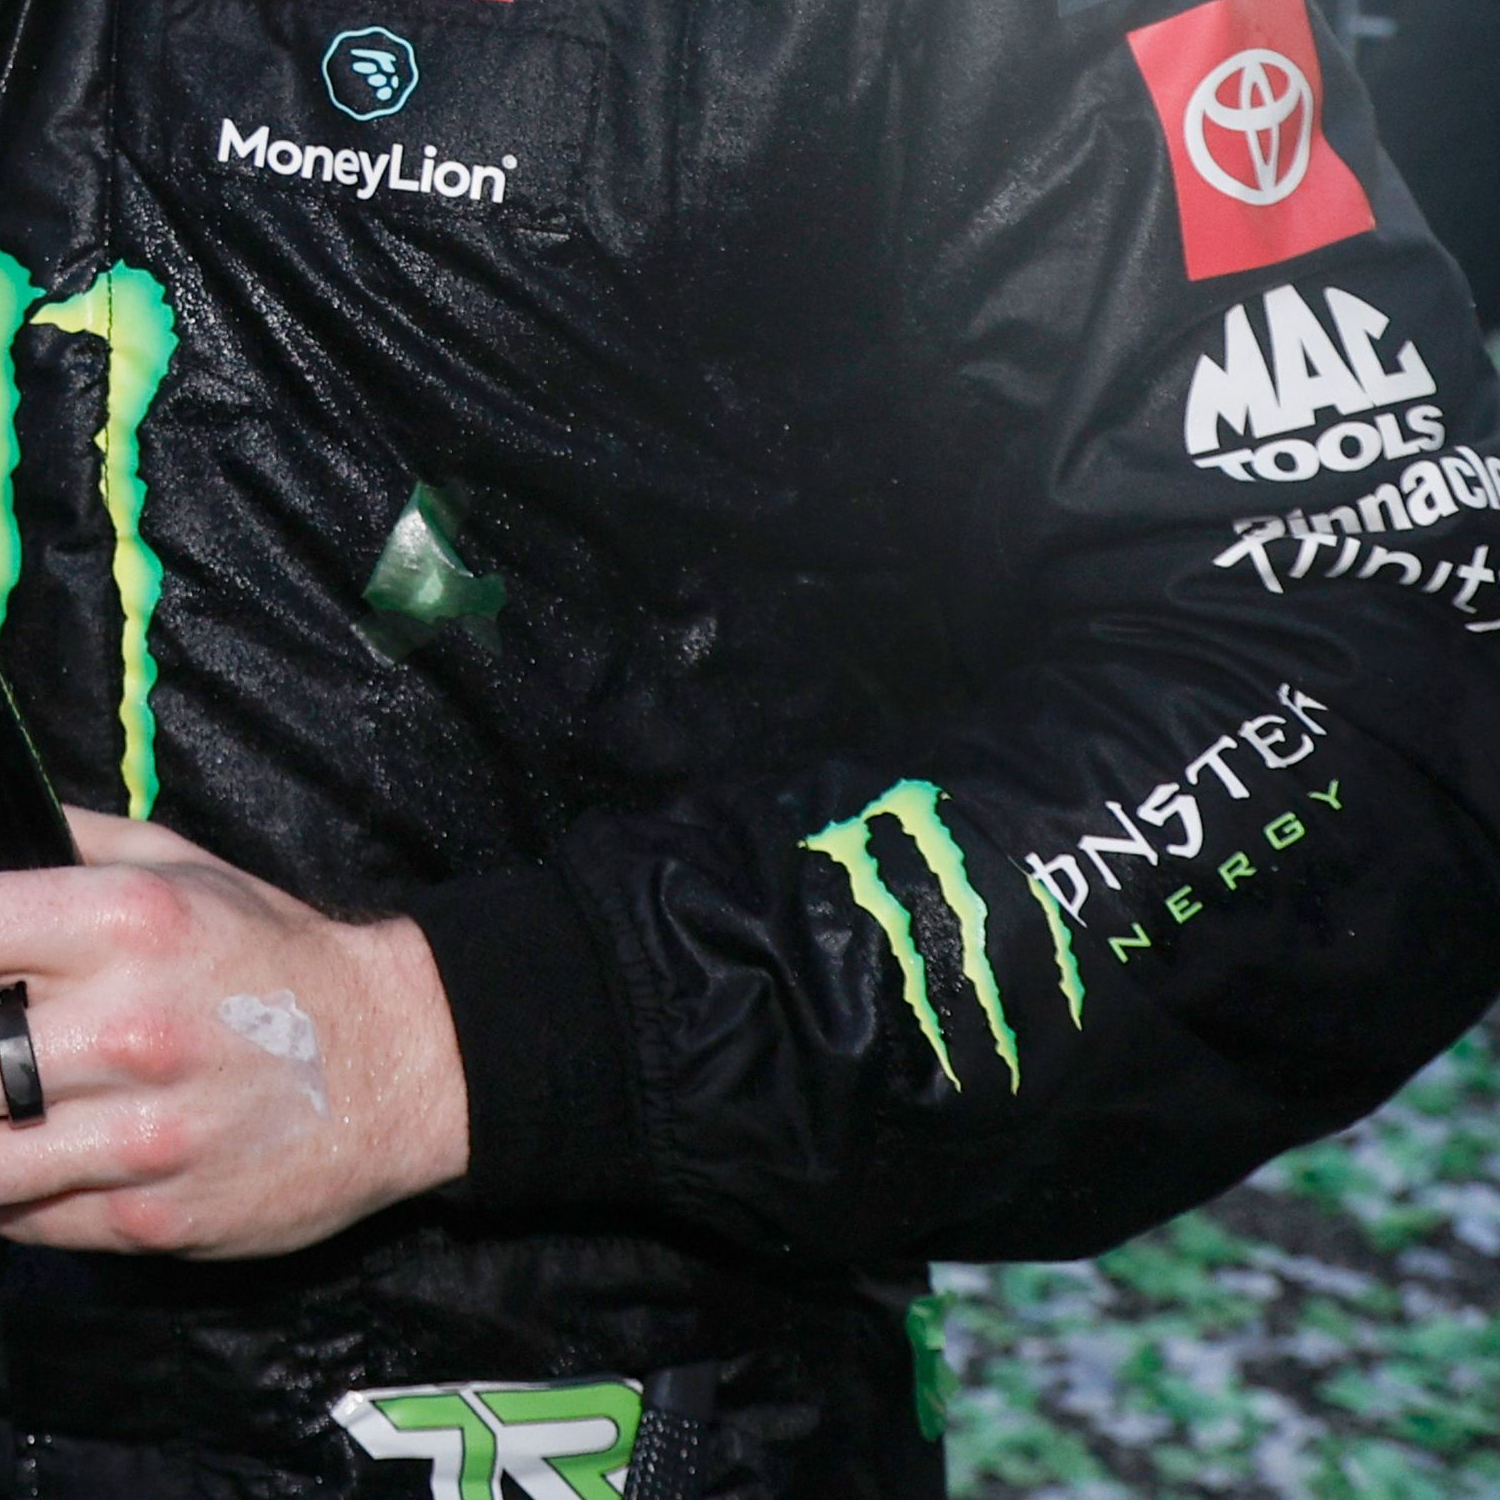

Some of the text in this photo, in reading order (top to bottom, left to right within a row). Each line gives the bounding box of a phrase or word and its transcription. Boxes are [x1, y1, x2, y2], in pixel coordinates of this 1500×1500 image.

[1184, 283, 1438, 456] MAC
[1193, 404, 1447, 482] TOOLS
[1232, 445, 1500, 540] Pinnacl
[1211, 531, 1500, 633] Trinit
[1108, 779, 1343, 964] NERGY
